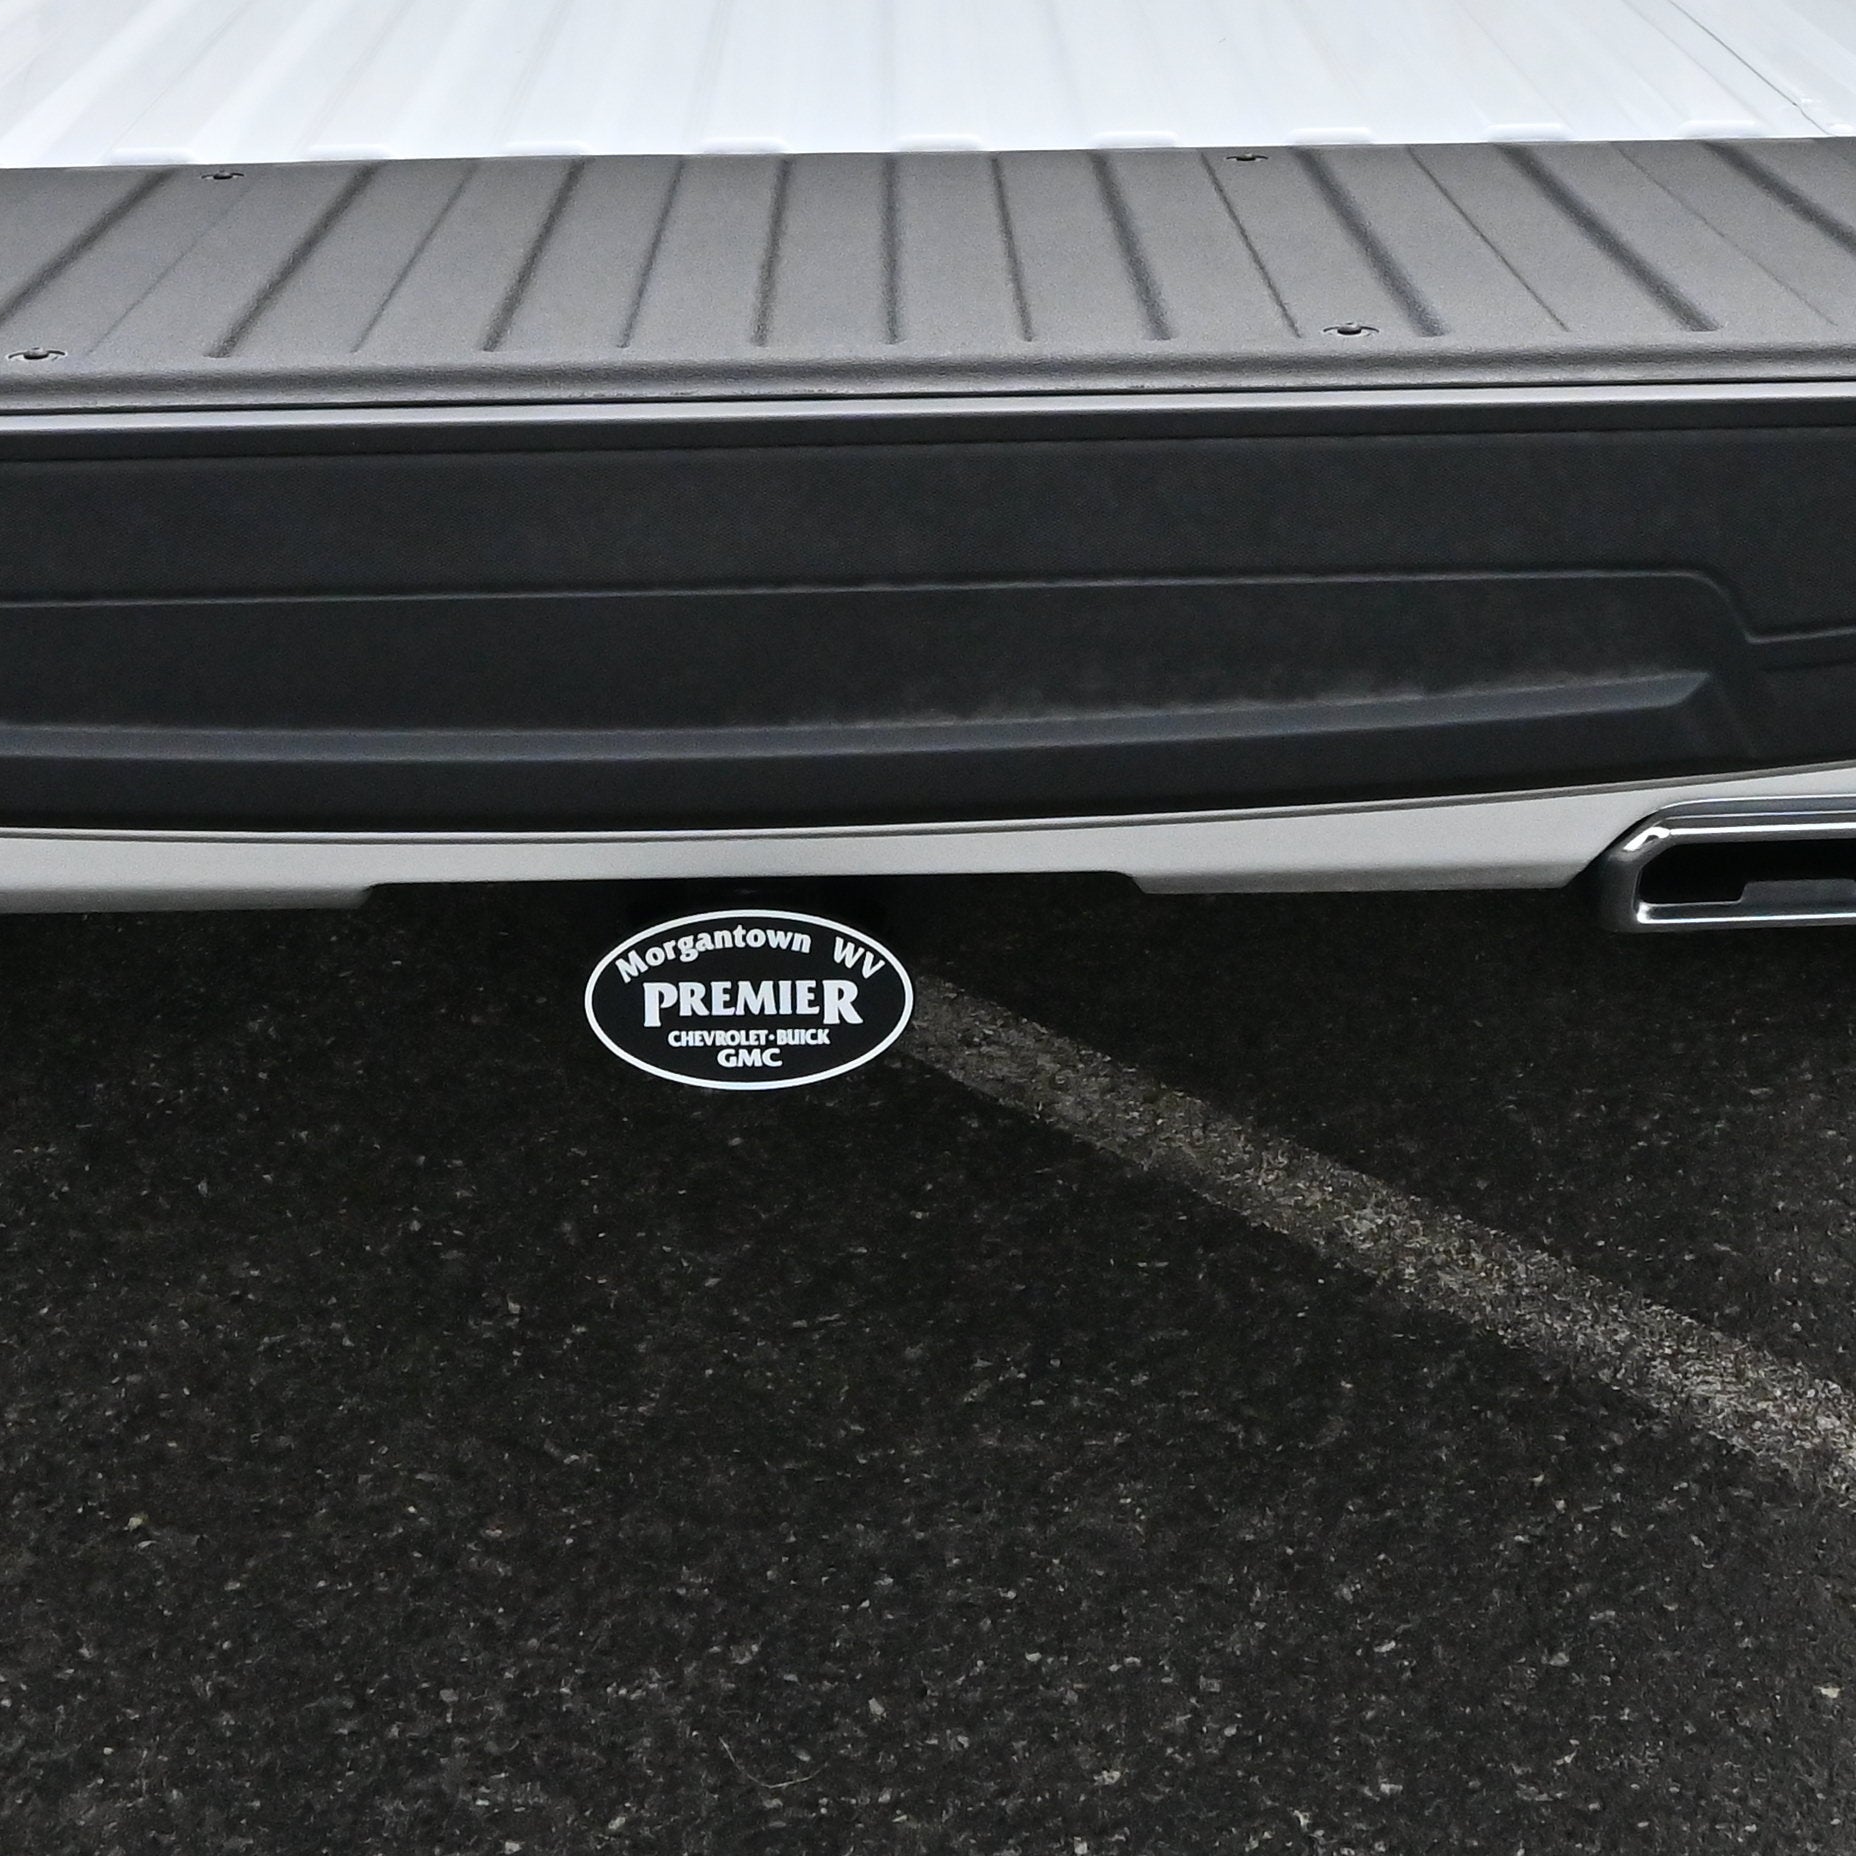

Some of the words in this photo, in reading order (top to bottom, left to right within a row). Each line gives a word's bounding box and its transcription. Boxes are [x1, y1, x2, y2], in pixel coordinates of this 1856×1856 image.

[615, 924, 812, 984] Morgantown
[833, 936, 886, 979] WV
[642, 979, 864, 1028] PREMIER
[667, 1029, 768, 1048] CHEVROLET
[776, 1028, 831, 1046] BUICK
[716, 1047, 783, 1068] GMC
